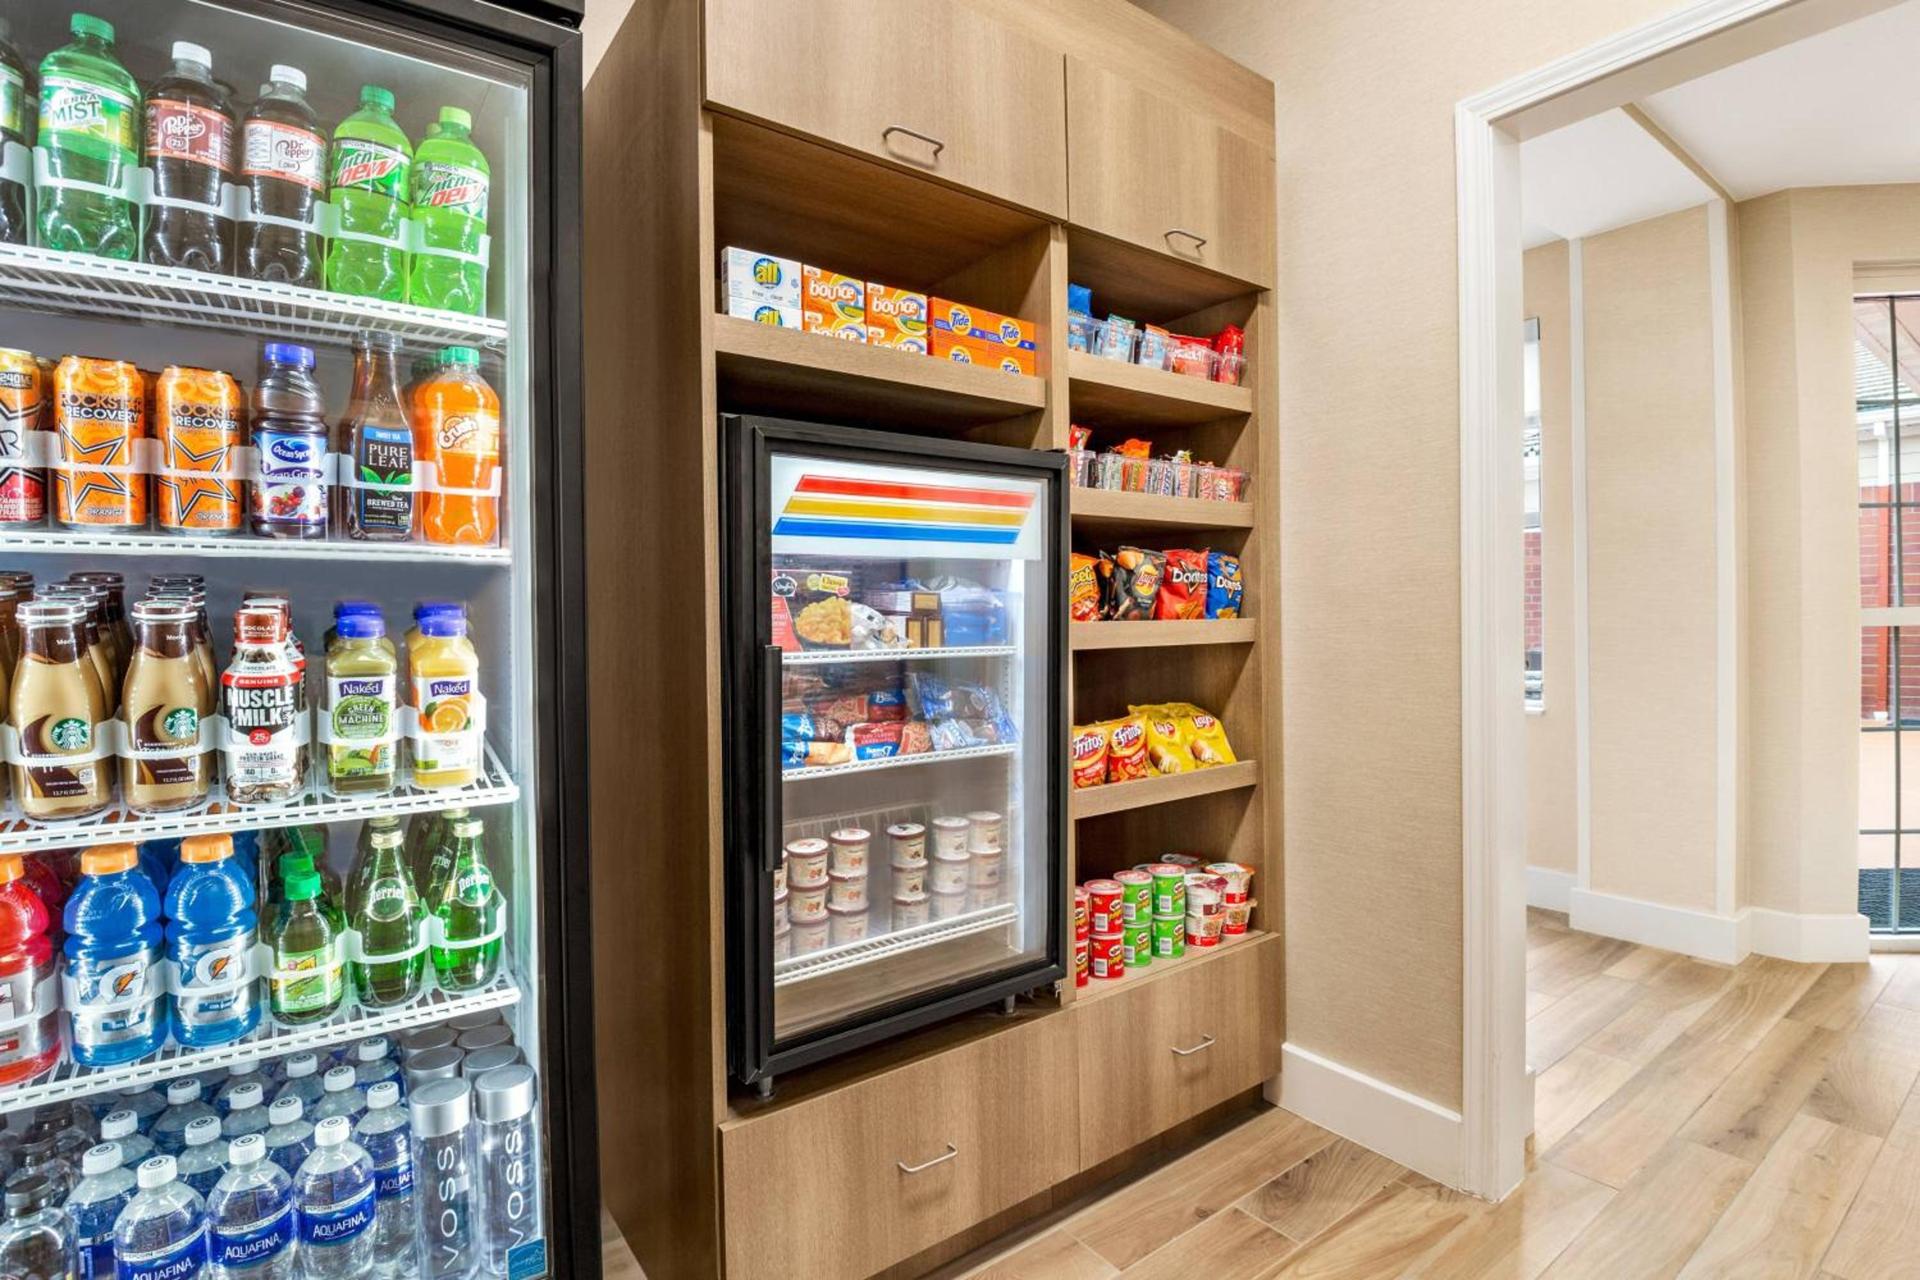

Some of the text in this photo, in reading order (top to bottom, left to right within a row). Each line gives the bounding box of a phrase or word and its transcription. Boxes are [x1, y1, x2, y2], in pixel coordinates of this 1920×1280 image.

[54, 100, 100, 122] MIST
[290, 139, 304, 149] Dr
[755, 262, 778, 284] all
[810, 279, 856, 299] bounce
[872, 297, 919, 315] bounce
[951, 311, 970, 327] Tide
[1001, 324, 1020, 340] Tide
[65, 406, 139, 423] RECOVERY
[175, 414, 239, 432] RECOVER
[273, 445, 294, 458] Ocean
[369, 443, 409, 457] PURE
[366, 499, 409, 509] BREWED TEA
[1172, 567, 1207, 583] Doritos
[227, 685, 294, 708] MUSCLE
[234, 707, 283, 727] MILK
[347, 703, 375, 714] GREEN
[339, 714, 385, 724] MACHINE
[1073, 735, 1103, 759] Fritos
[506, 1130, 524, 1248] VOSS
[437, 1146, 459, 1269] VOSS
[313, 1212, 366, 1238] AQUAFINA
[225, 1232, 282, 1259] AQUAFINA
[132, 1257, 195, 1280] AQUAFINA
